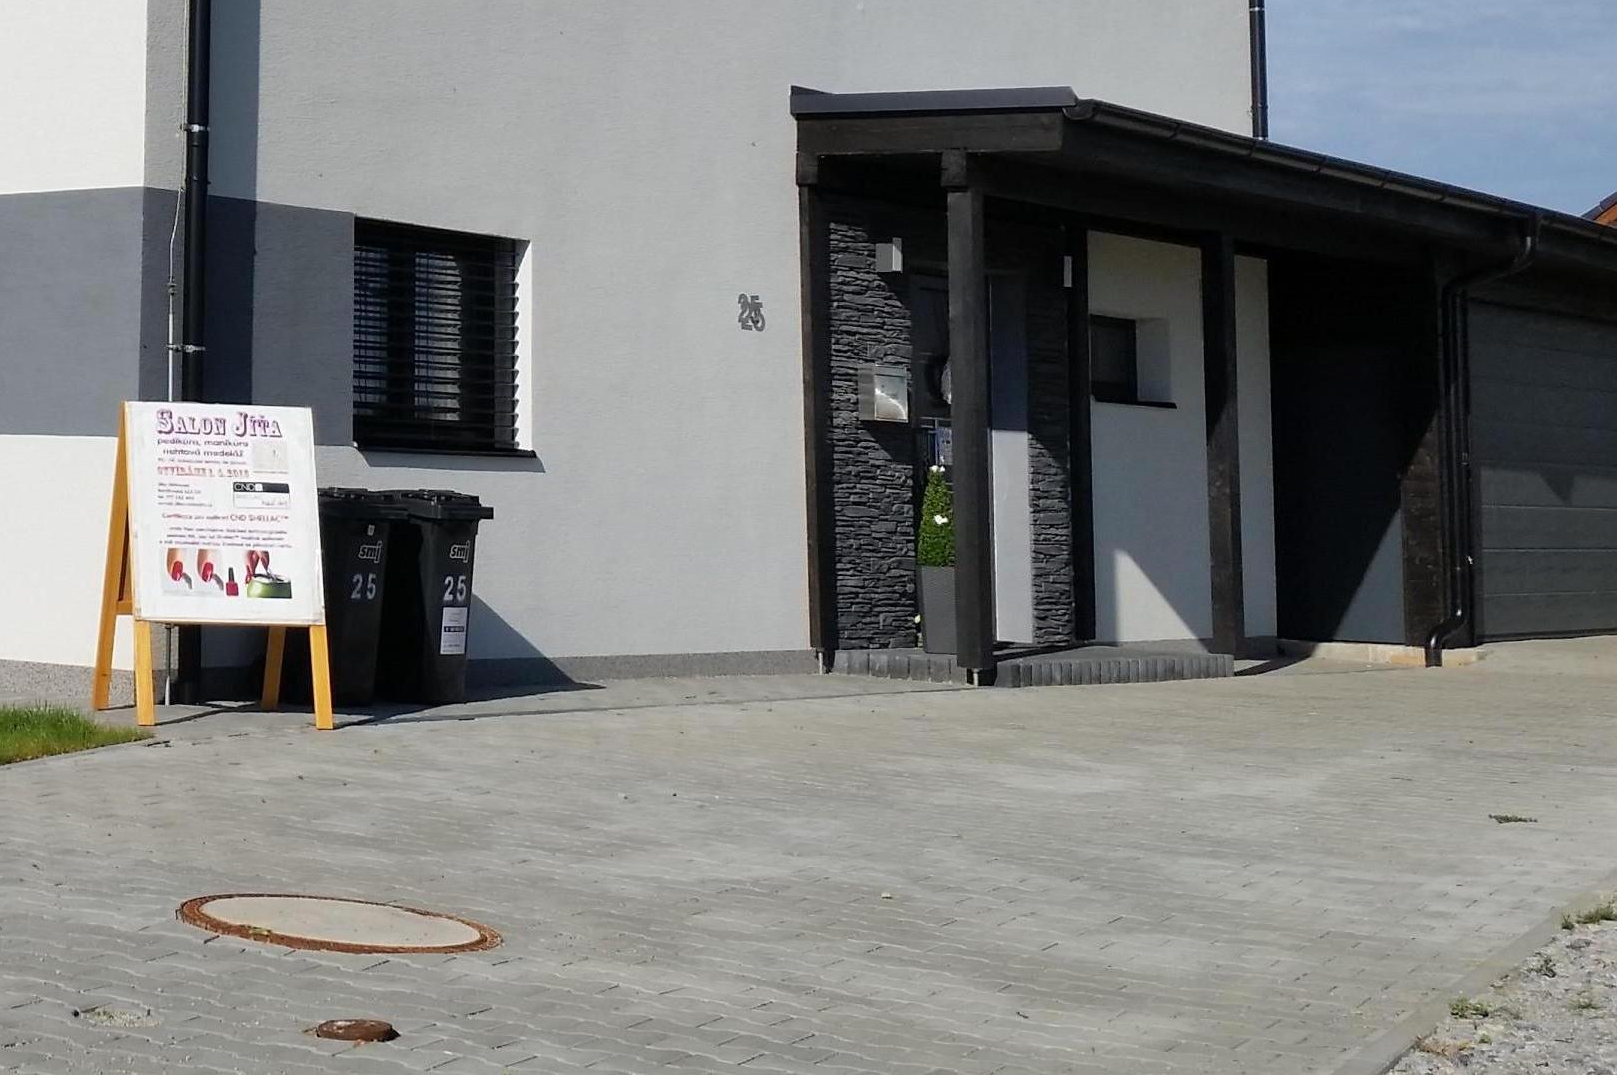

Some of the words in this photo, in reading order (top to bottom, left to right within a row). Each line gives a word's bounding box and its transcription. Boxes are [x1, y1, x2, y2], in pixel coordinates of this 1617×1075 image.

[738, 293, 764, 329] 25
[350, 574, 377, 600] 25
[443, 575, 467, 601] 25
